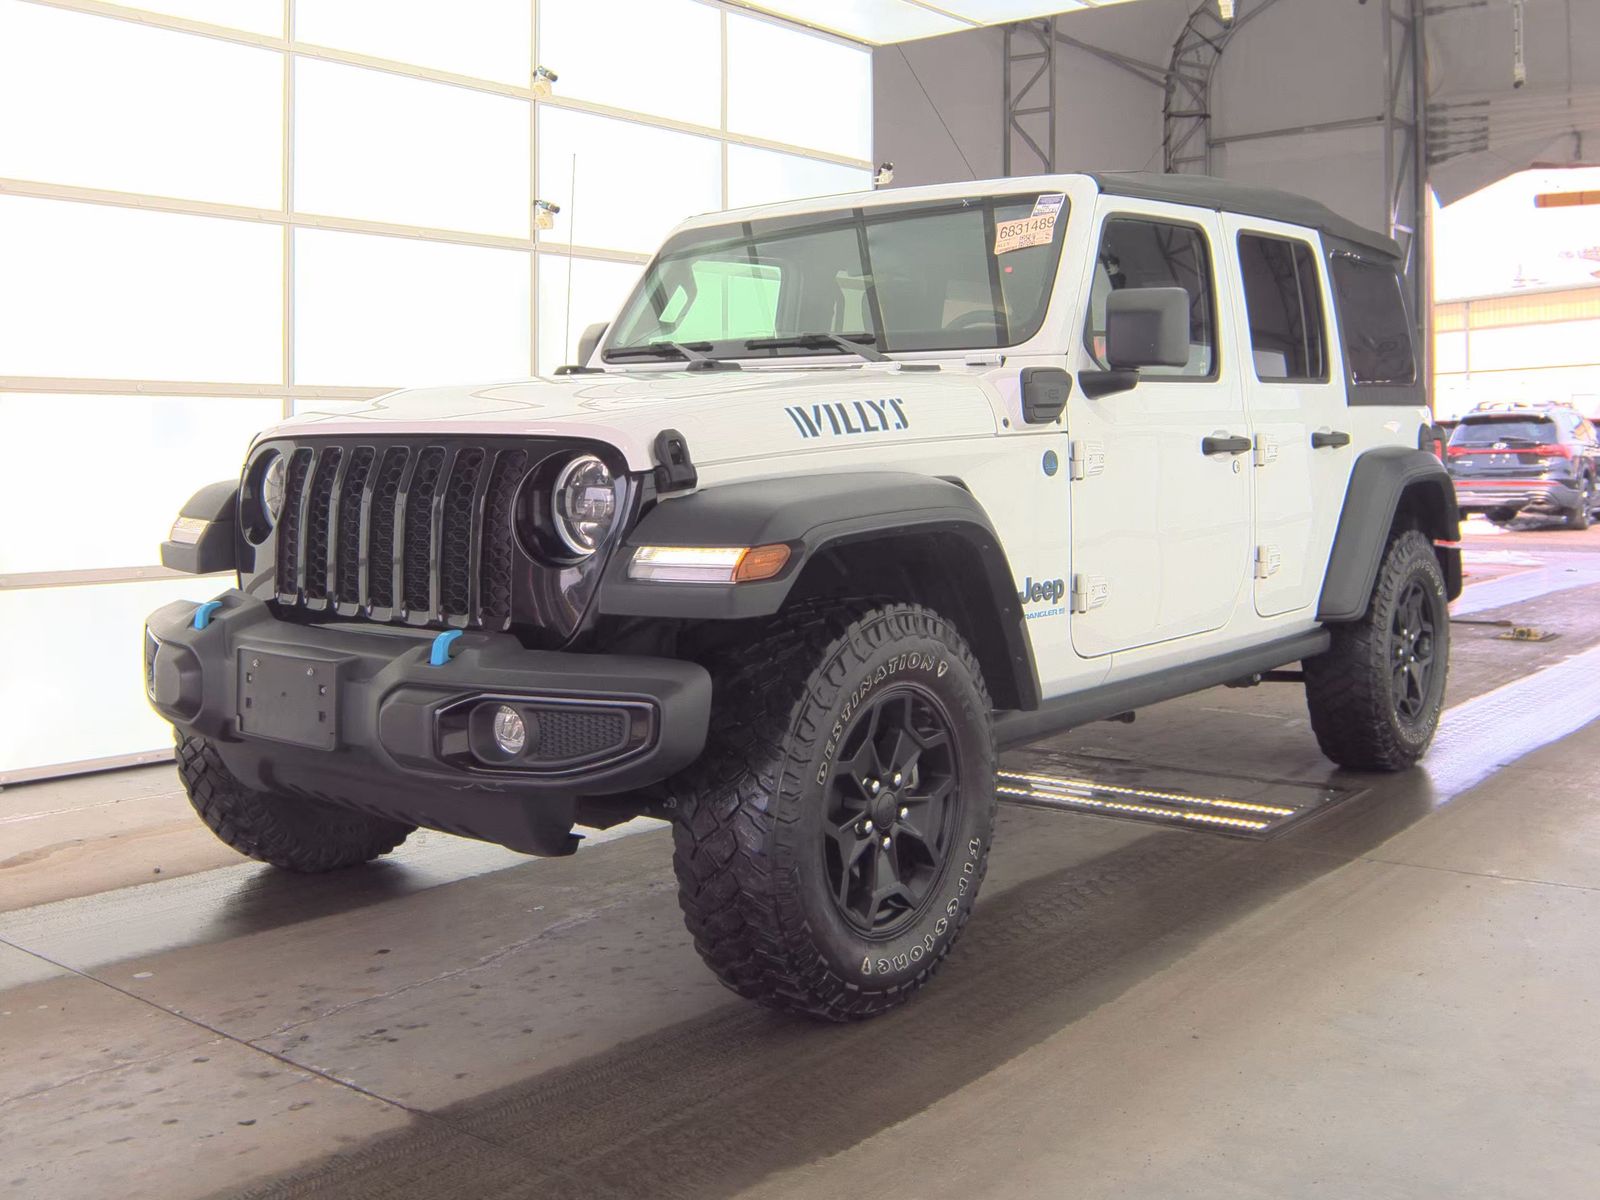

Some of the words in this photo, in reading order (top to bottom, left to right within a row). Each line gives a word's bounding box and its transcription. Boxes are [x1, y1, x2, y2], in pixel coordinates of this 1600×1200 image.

[1000, 216, 1054, 239] 6831489
[784, 398, 909, 438] WILLYS
[1018, 577, 1065, 604] Jeep
[1024, 608, 1058, 620] RANGLER
[816, 652, 936, 786] DESTINATION
